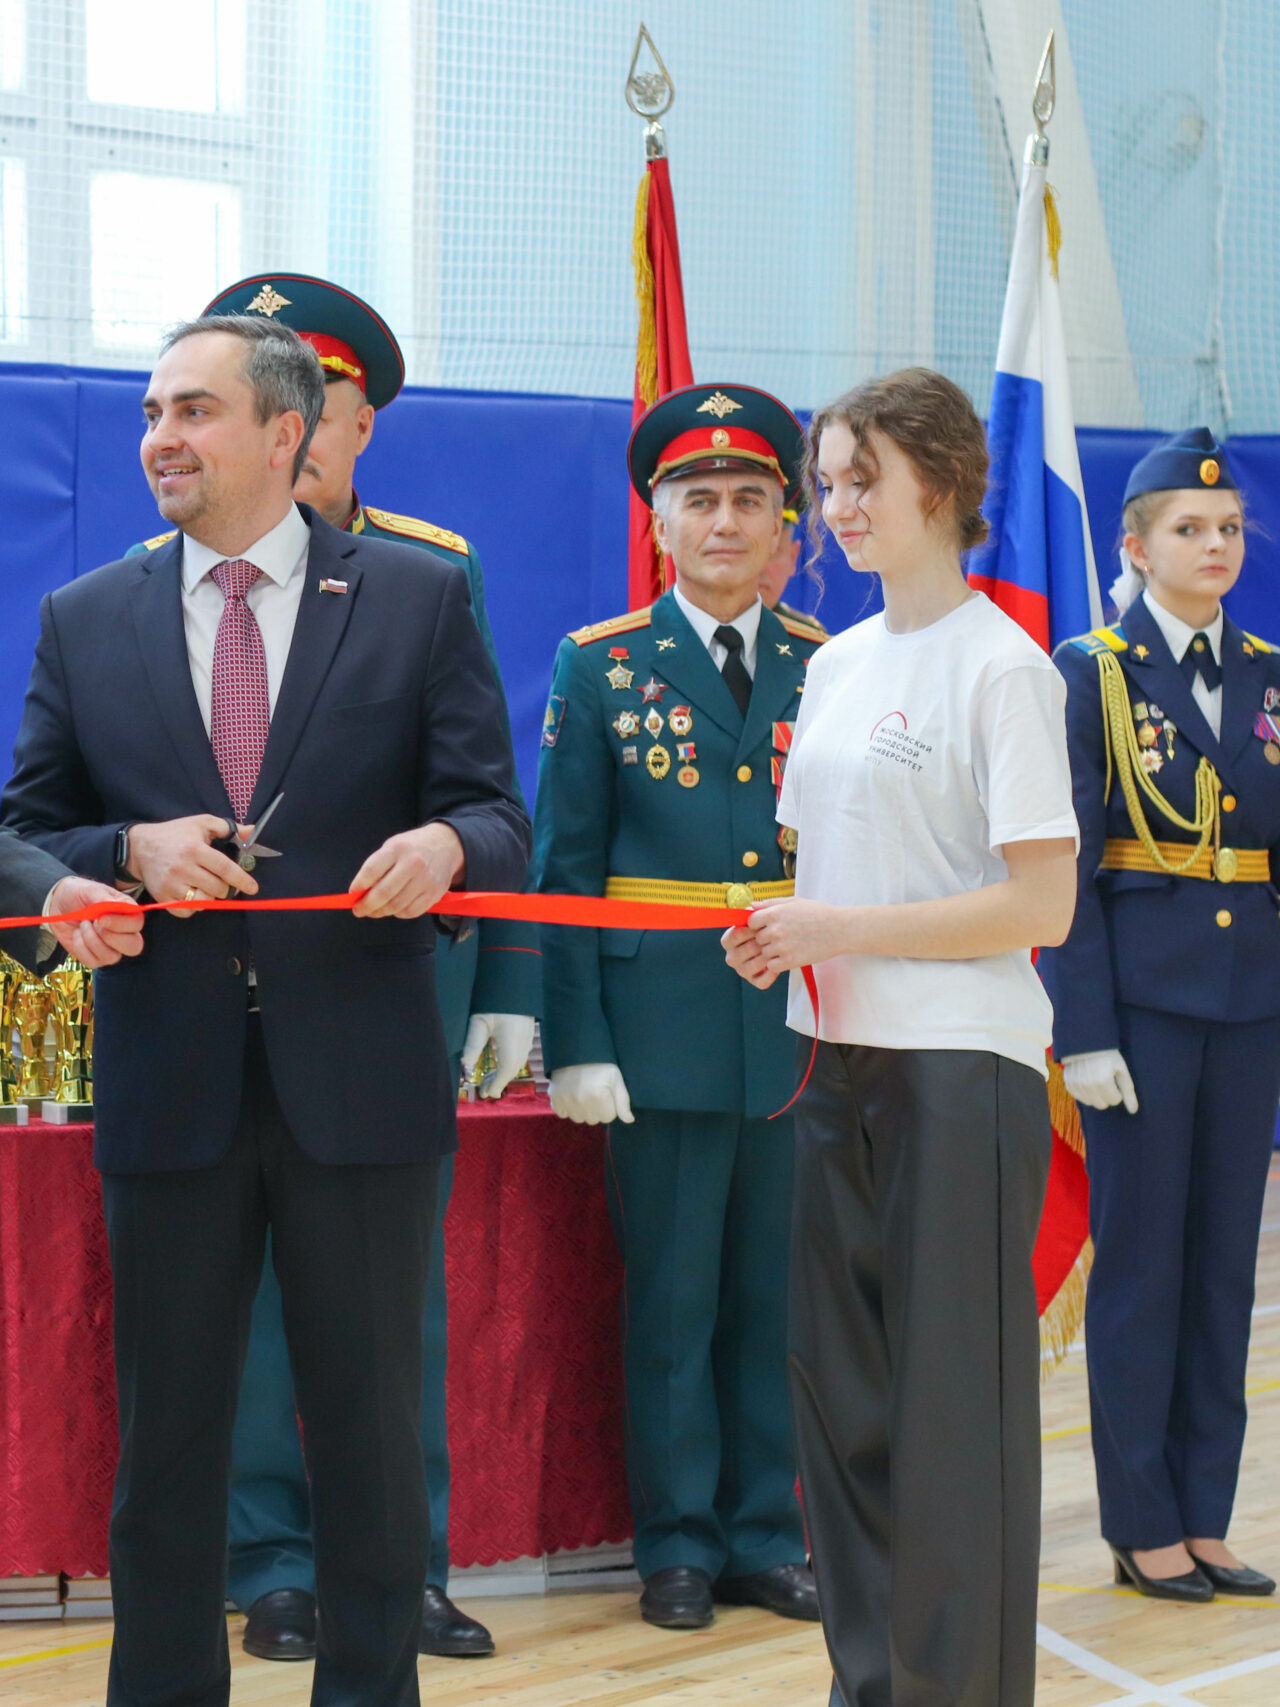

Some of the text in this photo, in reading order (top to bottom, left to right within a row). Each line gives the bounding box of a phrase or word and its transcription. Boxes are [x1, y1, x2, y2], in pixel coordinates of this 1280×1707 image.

[874, 736, 920, 759] ГОРОДСКОЙ
[881, 727, 932, 753] МОСКОВСКИЙ
[869, 745, 923, 772] УНИВЕРСИТЕТ
